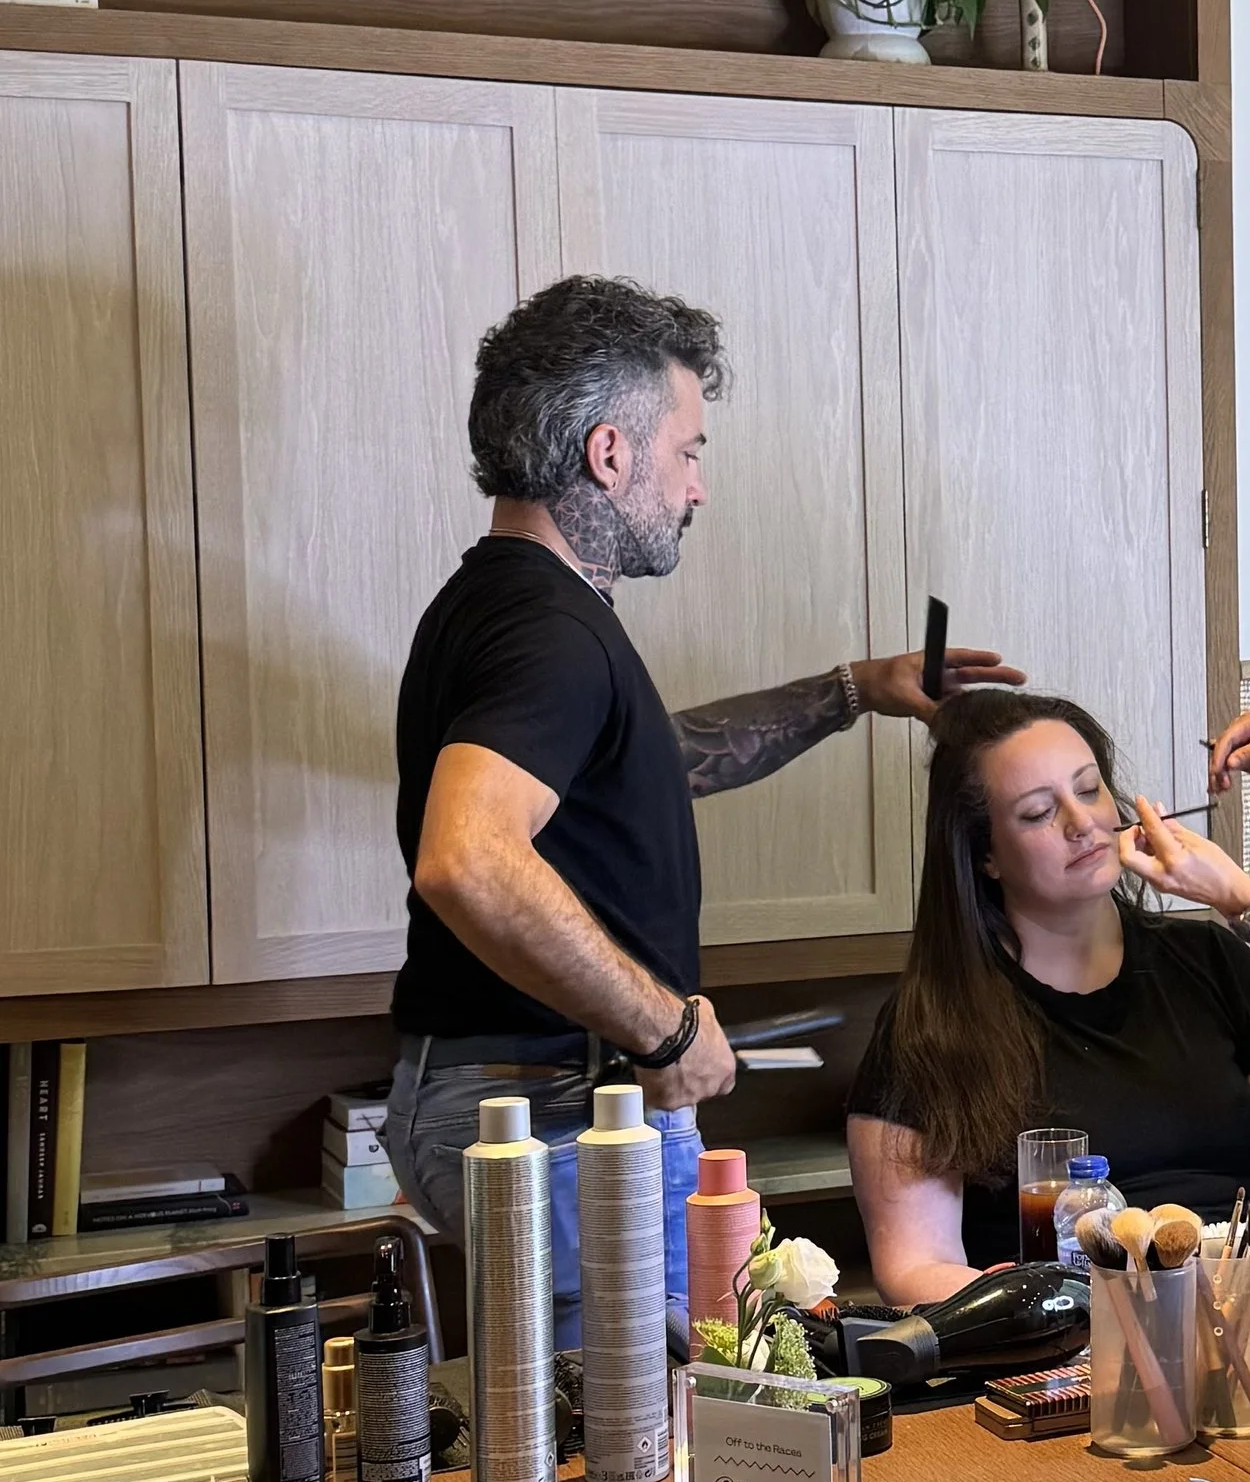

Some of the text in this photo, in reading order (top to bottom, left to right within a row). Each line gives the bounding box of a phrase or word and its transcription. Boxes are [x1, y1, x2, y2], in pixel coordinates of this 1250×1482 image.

[37, 1079, 49, 1121] HEART
[725, 1436, 803, 1458] Off to the Races
